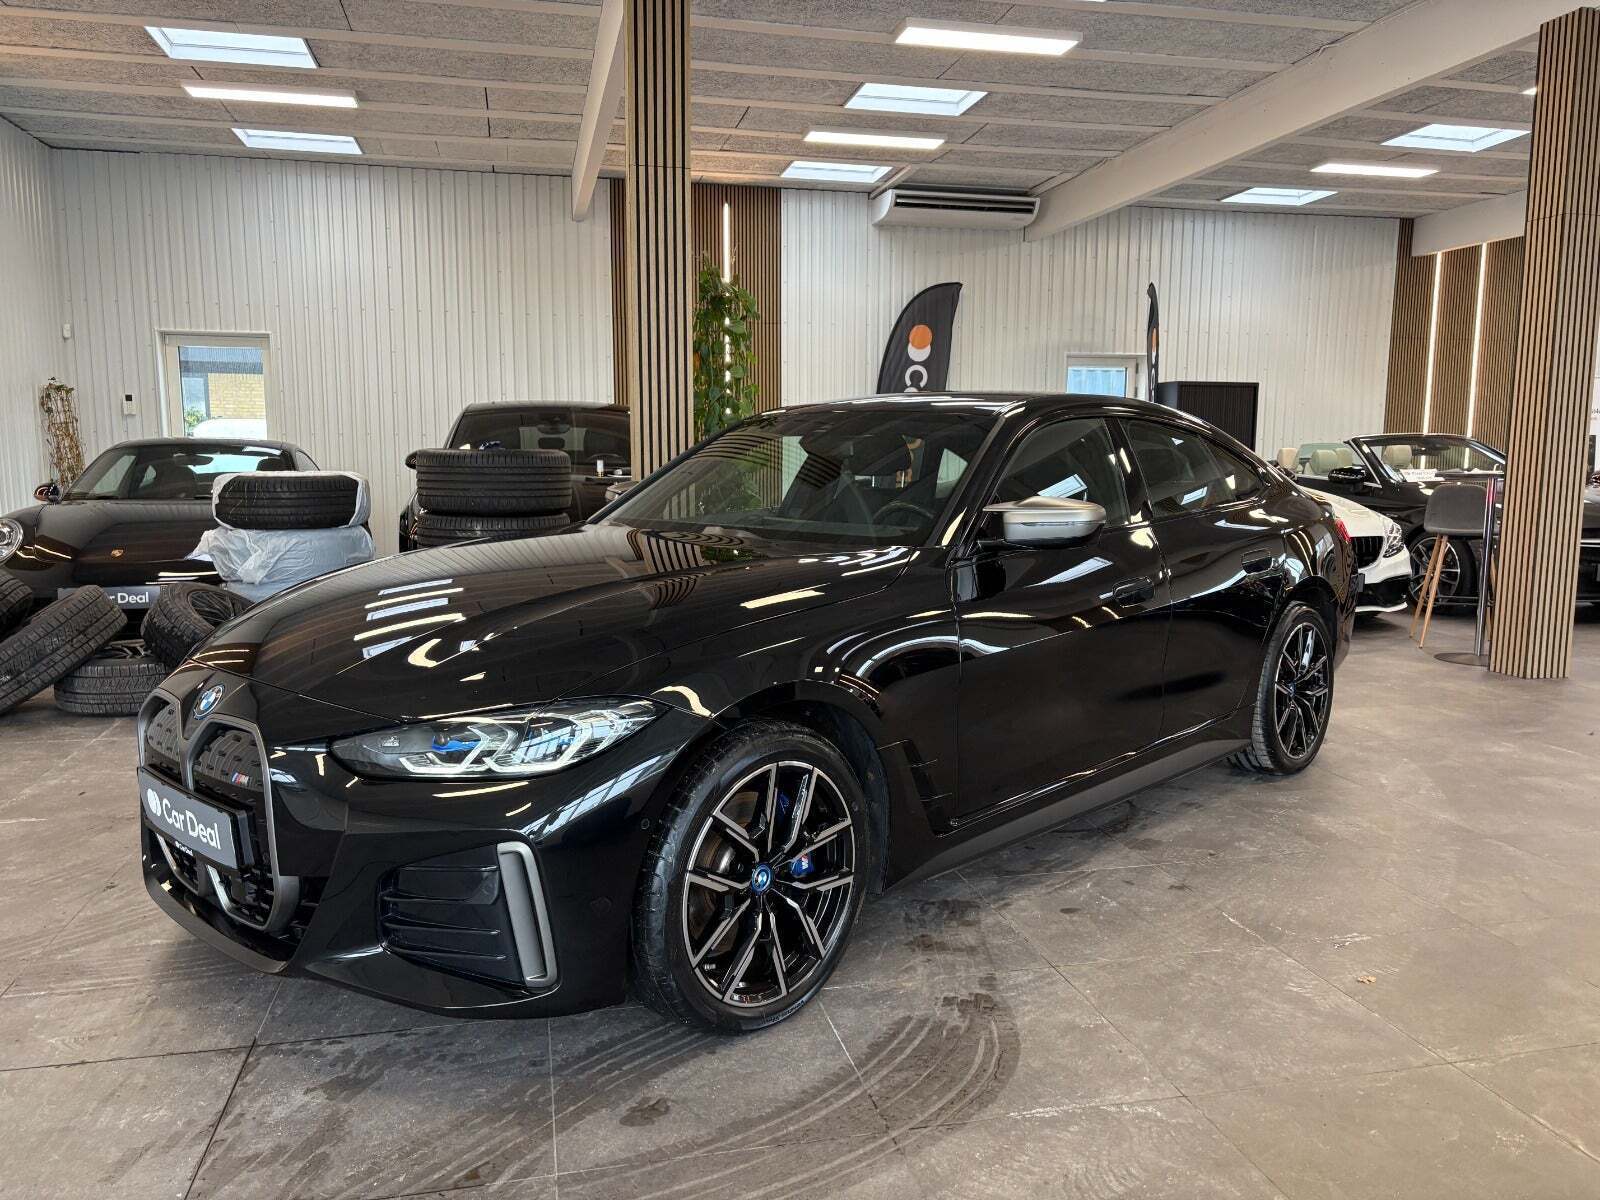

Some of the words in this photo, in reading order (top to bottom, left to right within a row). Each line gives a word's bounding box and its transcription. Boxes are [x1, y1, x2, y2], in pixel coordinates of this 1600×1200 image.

[117, 592, 149, 604] Deal
[162, 798, 185, 832] Car
[185, 810, 221, 850] Deal
